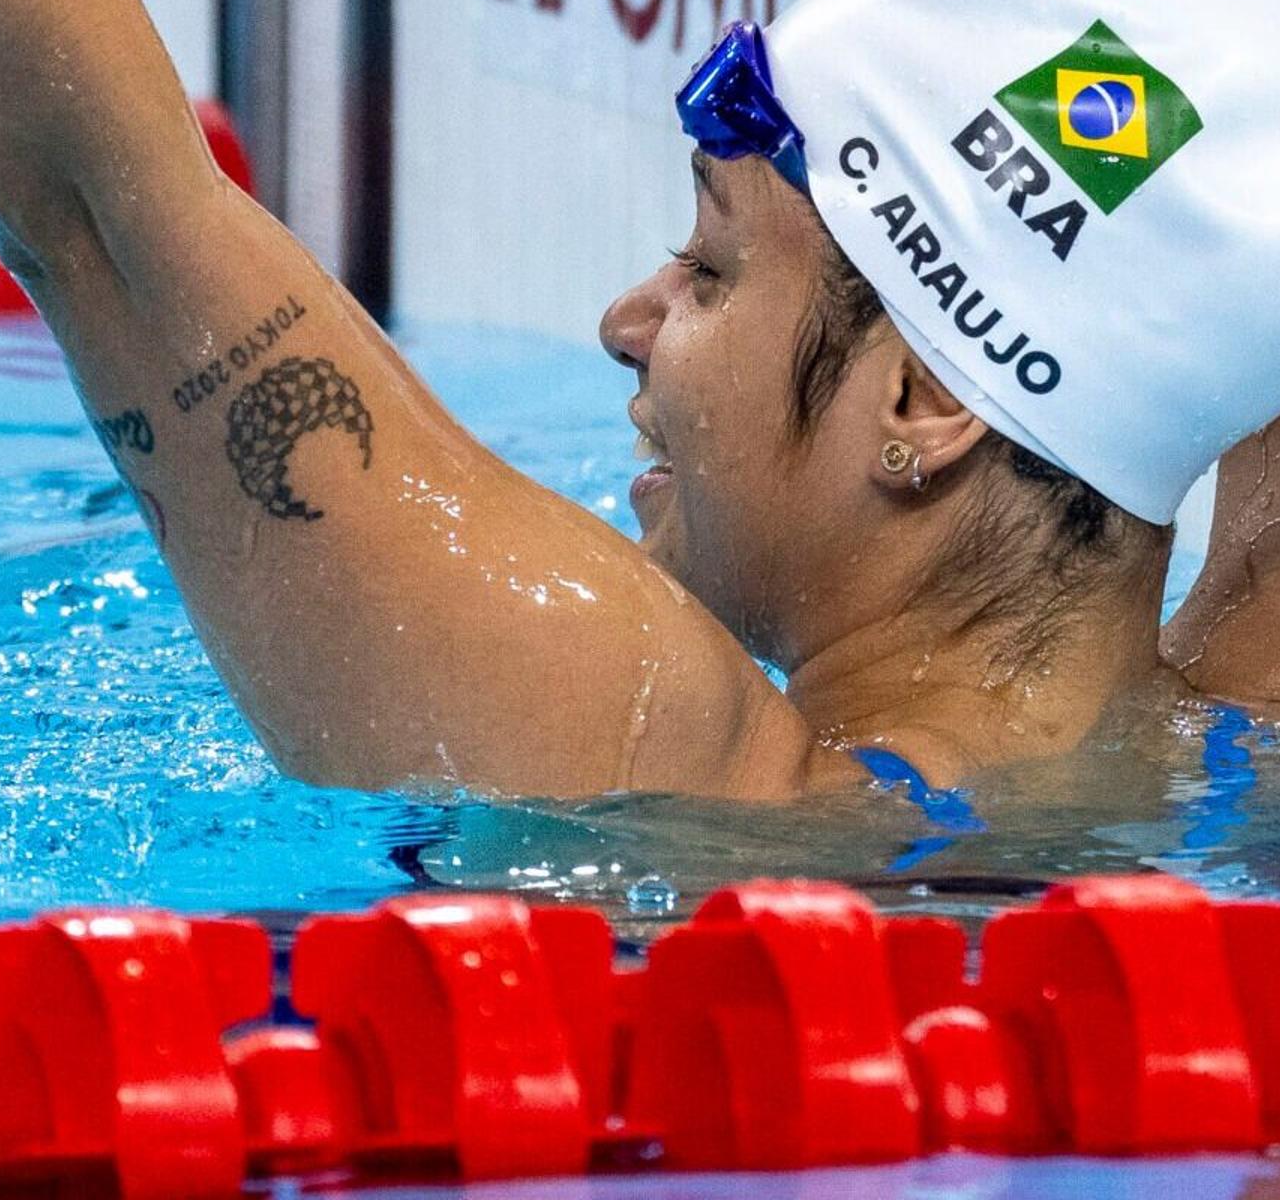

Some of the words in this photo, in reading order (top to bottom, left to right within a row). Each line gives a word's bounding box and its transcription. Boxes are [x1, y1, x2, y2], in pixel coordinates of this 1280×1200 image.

[951, 108, 1088, 261] BRA
[838, 137, 880, 193] C.
[871, 194, 1062, 394] ARAUJO
[172, 360, 231, 413] 2020
[229, 295, 307, 370] TOKYO
